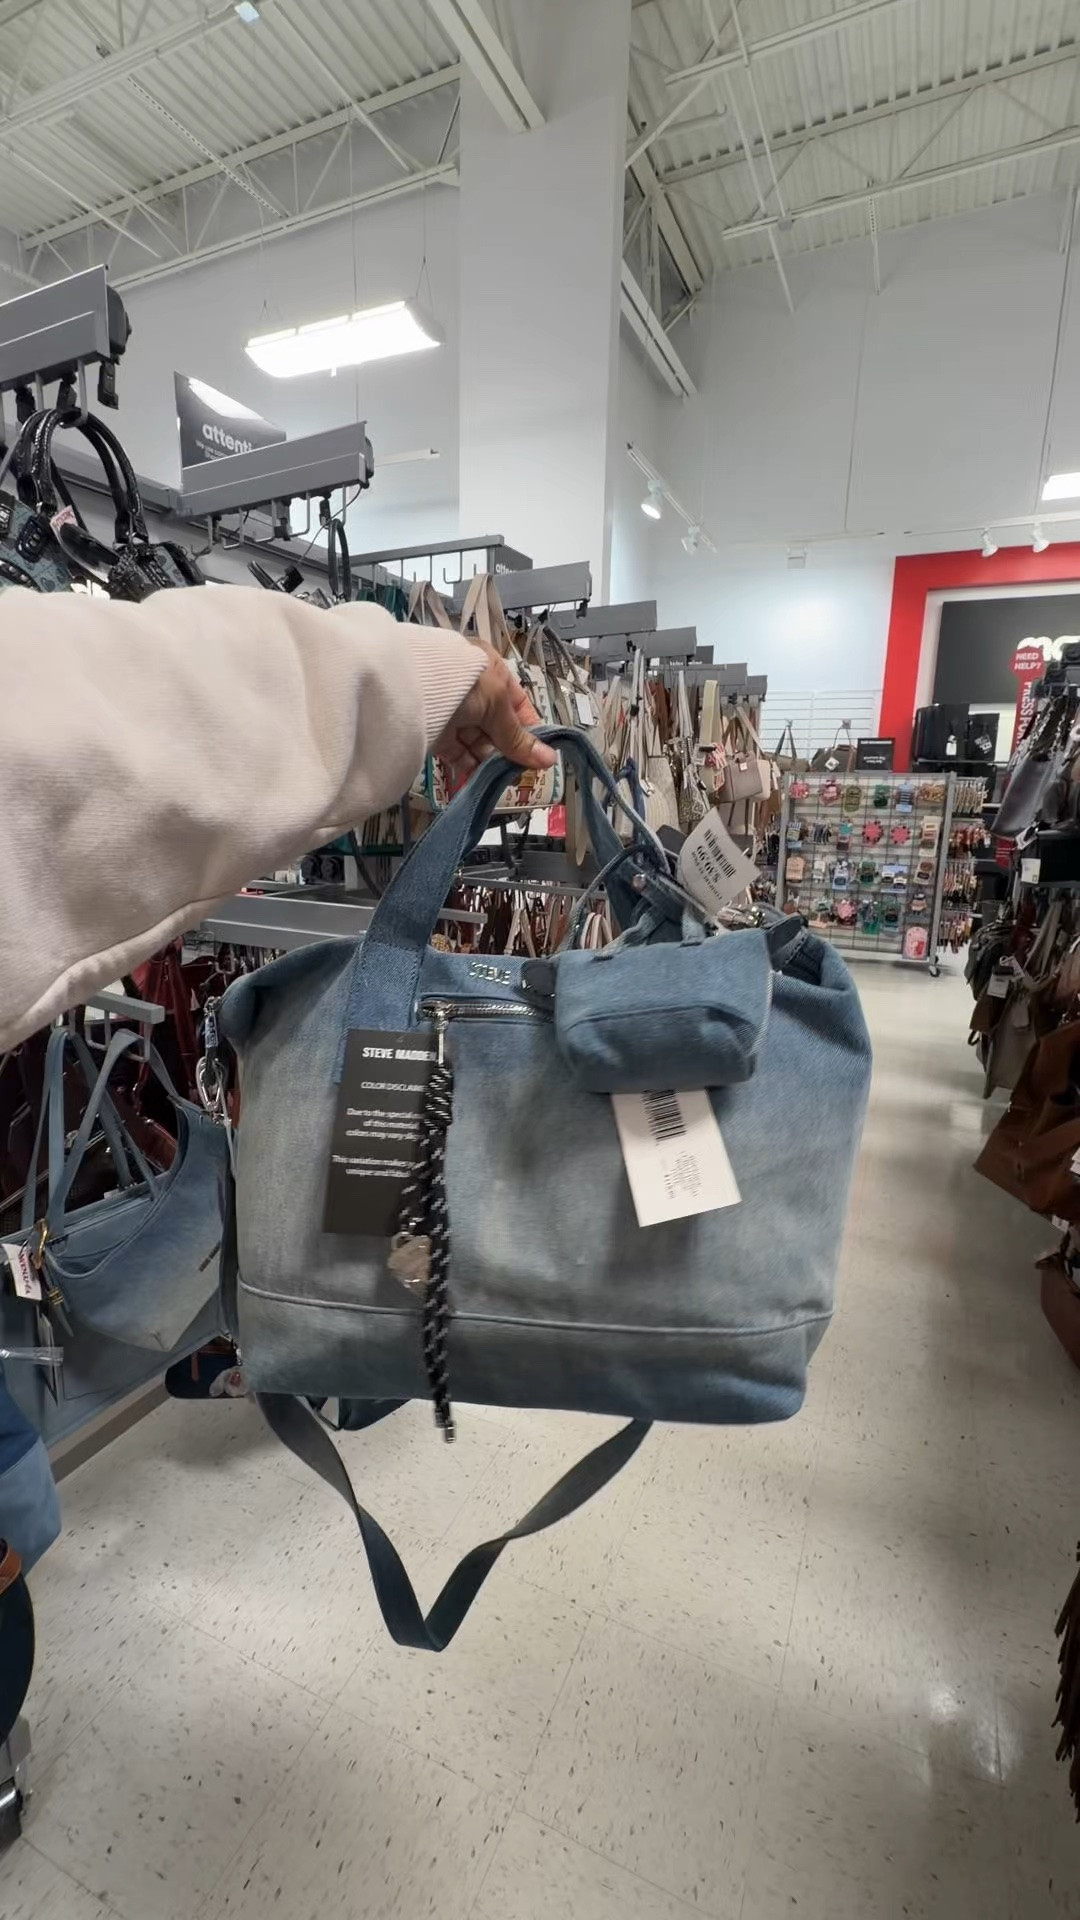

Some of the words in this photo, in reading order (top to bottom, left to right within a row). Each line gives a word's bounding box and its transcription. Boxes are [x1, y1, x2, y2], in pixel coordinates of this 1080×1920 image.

[1016, 653, 1039, 661] NEED
[1014, 662, 1042, 671] HELP?
[362, 1047, 394, 1059] STEVE
[361, 1081, 385, 1090] COLOR
